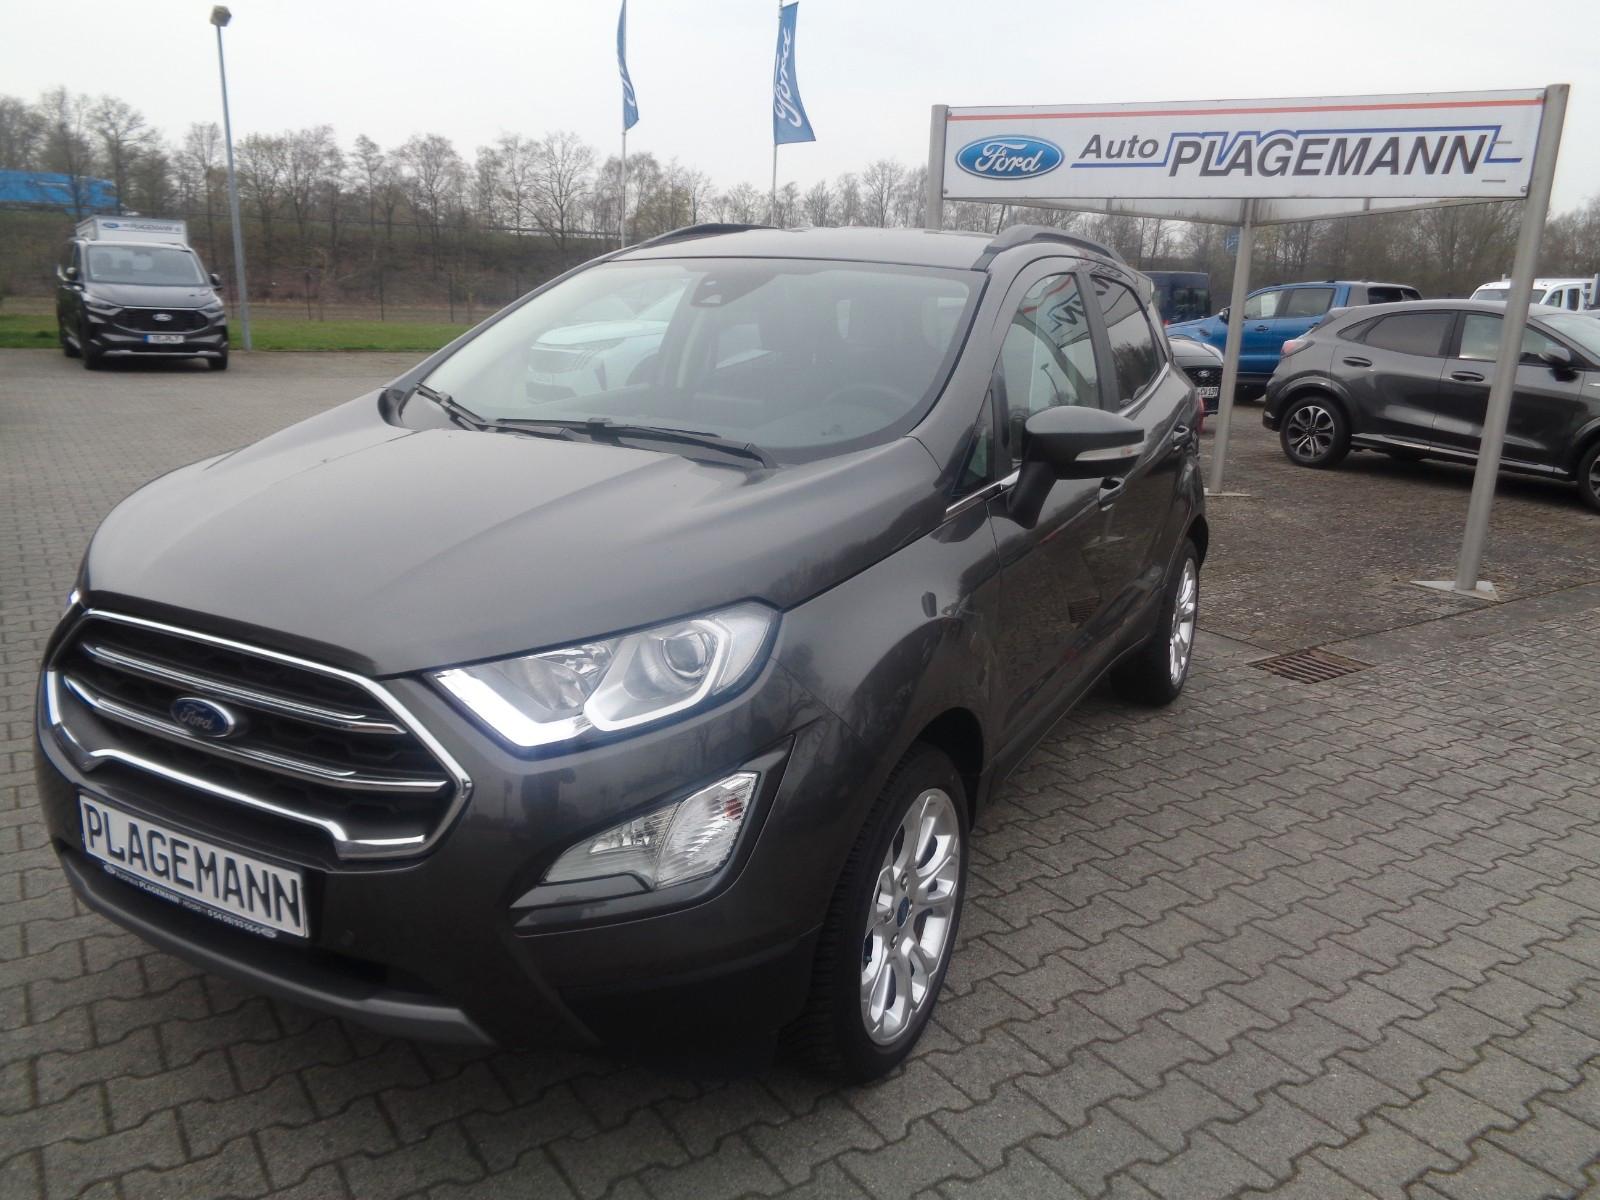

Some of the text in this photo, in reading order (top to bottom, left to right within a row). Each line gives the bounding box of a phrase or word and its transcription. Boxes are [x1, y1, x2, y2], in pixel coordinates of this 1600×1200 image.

[975, 142, 1044, 173] Ford
[1078, 134, 1488, 177] Auto PLAGEMANN
[83, 801, 301, 928] PLAGEMANN
